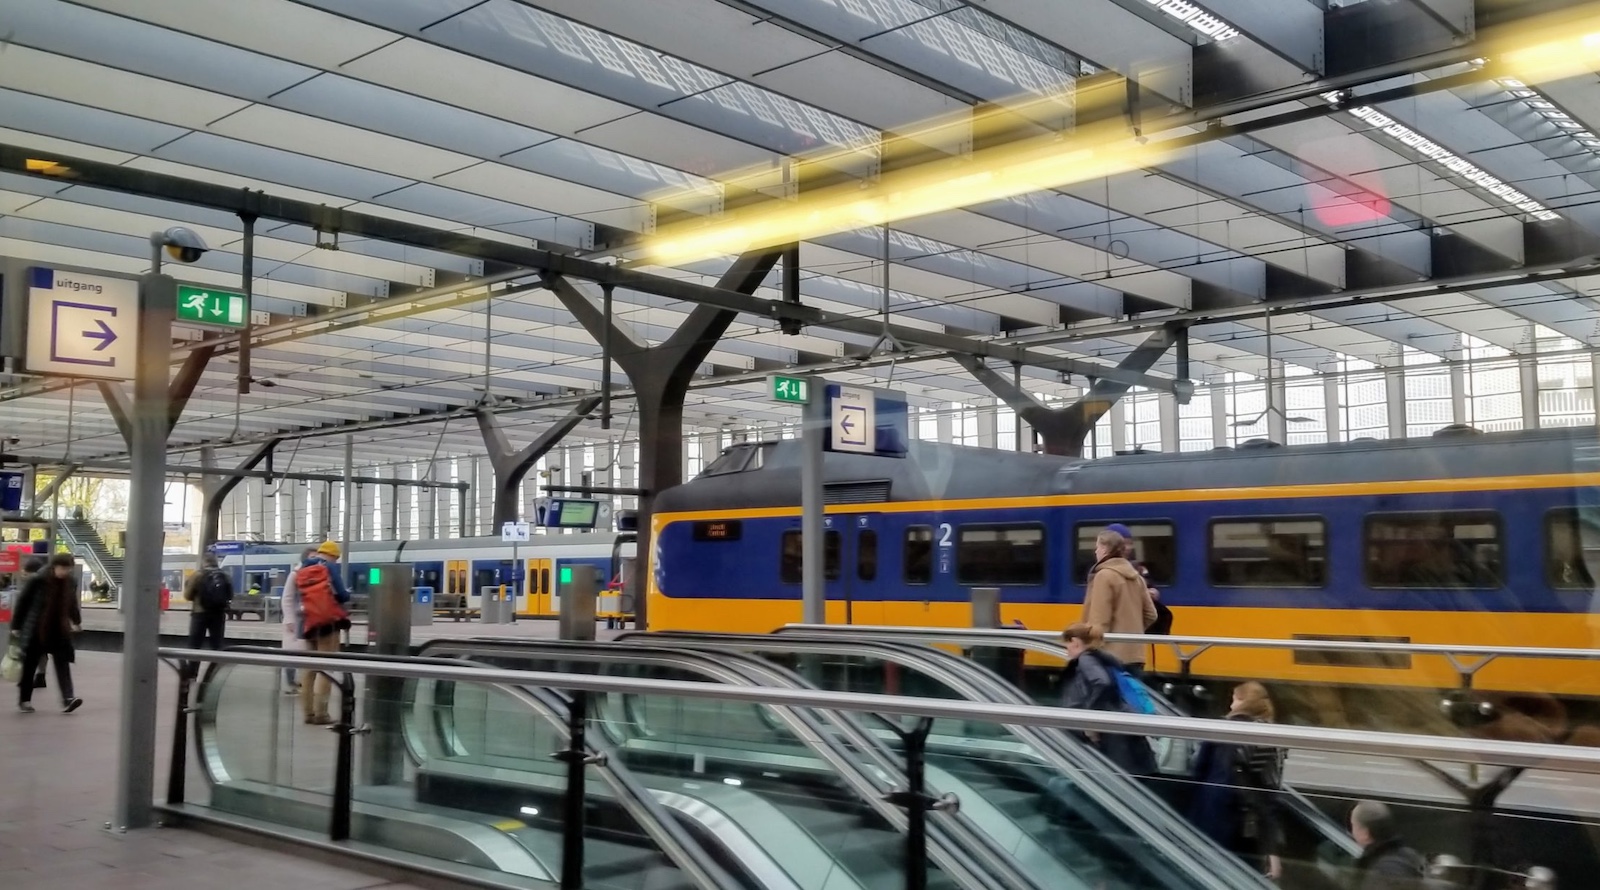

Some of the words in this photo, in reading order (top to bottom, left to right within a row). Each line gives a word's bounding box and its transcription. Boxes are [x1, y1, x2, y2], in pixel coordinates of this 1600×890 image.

[56, 279, 102, 294] uitgang
[939, 523, 952, 546] 2
[420, 570, 425, 578] 2
[495, 569, 500, 577] 2
